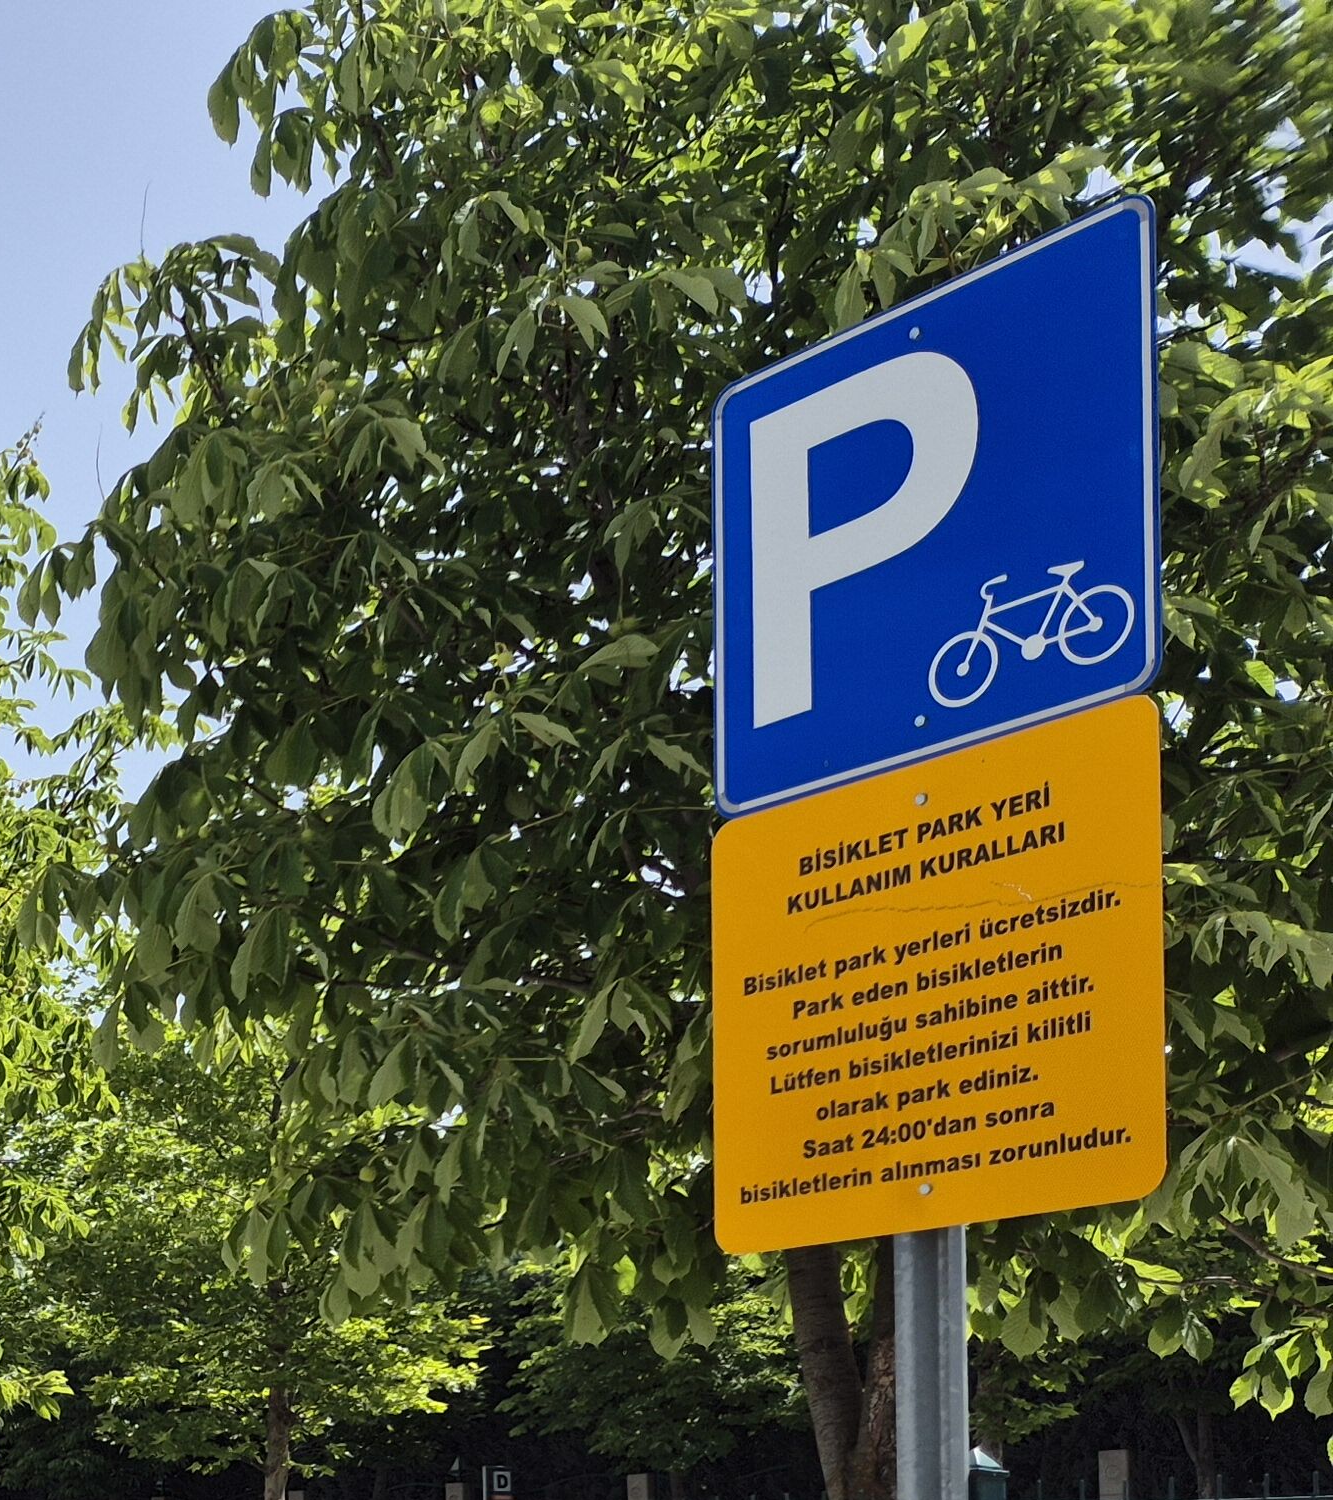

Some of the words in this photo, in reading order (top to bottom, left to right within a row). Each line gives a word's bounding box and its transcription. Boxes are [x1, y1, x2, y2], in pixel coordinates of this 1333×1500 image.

[749, 350, 980, 730] P
[787, 863, 912, 915] KULLANIM
[920, 821, 1065, 880] KURALLARI
[799, 827, 909, 877] BİSİKLET
[917, 805, 983, 844] PARK
[990, 780, 1050, 822] YERİ
[743, 959, 827, 997] Bisiklet
[834, 945, 887, 980] park
[893, 922, 971, 966] yerleri
[979, 888, 1121, 940] ücretsizdir.
[792, 991, 844, 1020] Park
[851, 980, 909, 1007] eden
[916, 942, 1063, 992] bisikletlerin
[766, 1015, 907, 1061] sorumluluğu
[915, 993, 1019, 1029] sahibine
[1026, 974, 1094, 1006] aittir.
[770, 1068, 841, 1095] Lütfen
[848, 1025, 1018, 1080] bisikletlerinizi
[1027, 1010, 1091, 1044] kilitli
[802, 1133, 854, 1160] Saat
[861, 1115, 977, 1150] 24:00'dan
[985, 1101, 1055, 1128] sonra
[816, 1091, 890, 1121] olarak
[897, 1078, 951, 1112] park
[958, 1064, 1039, 1095] ediniz.
[740, 1167, 873, 1205] bisikletlerin
[880, 1152, 981, 1183] alınması
[988, 1126, 1132, 1166] zorunludur.
[496, 1474, 509, 1489] D
